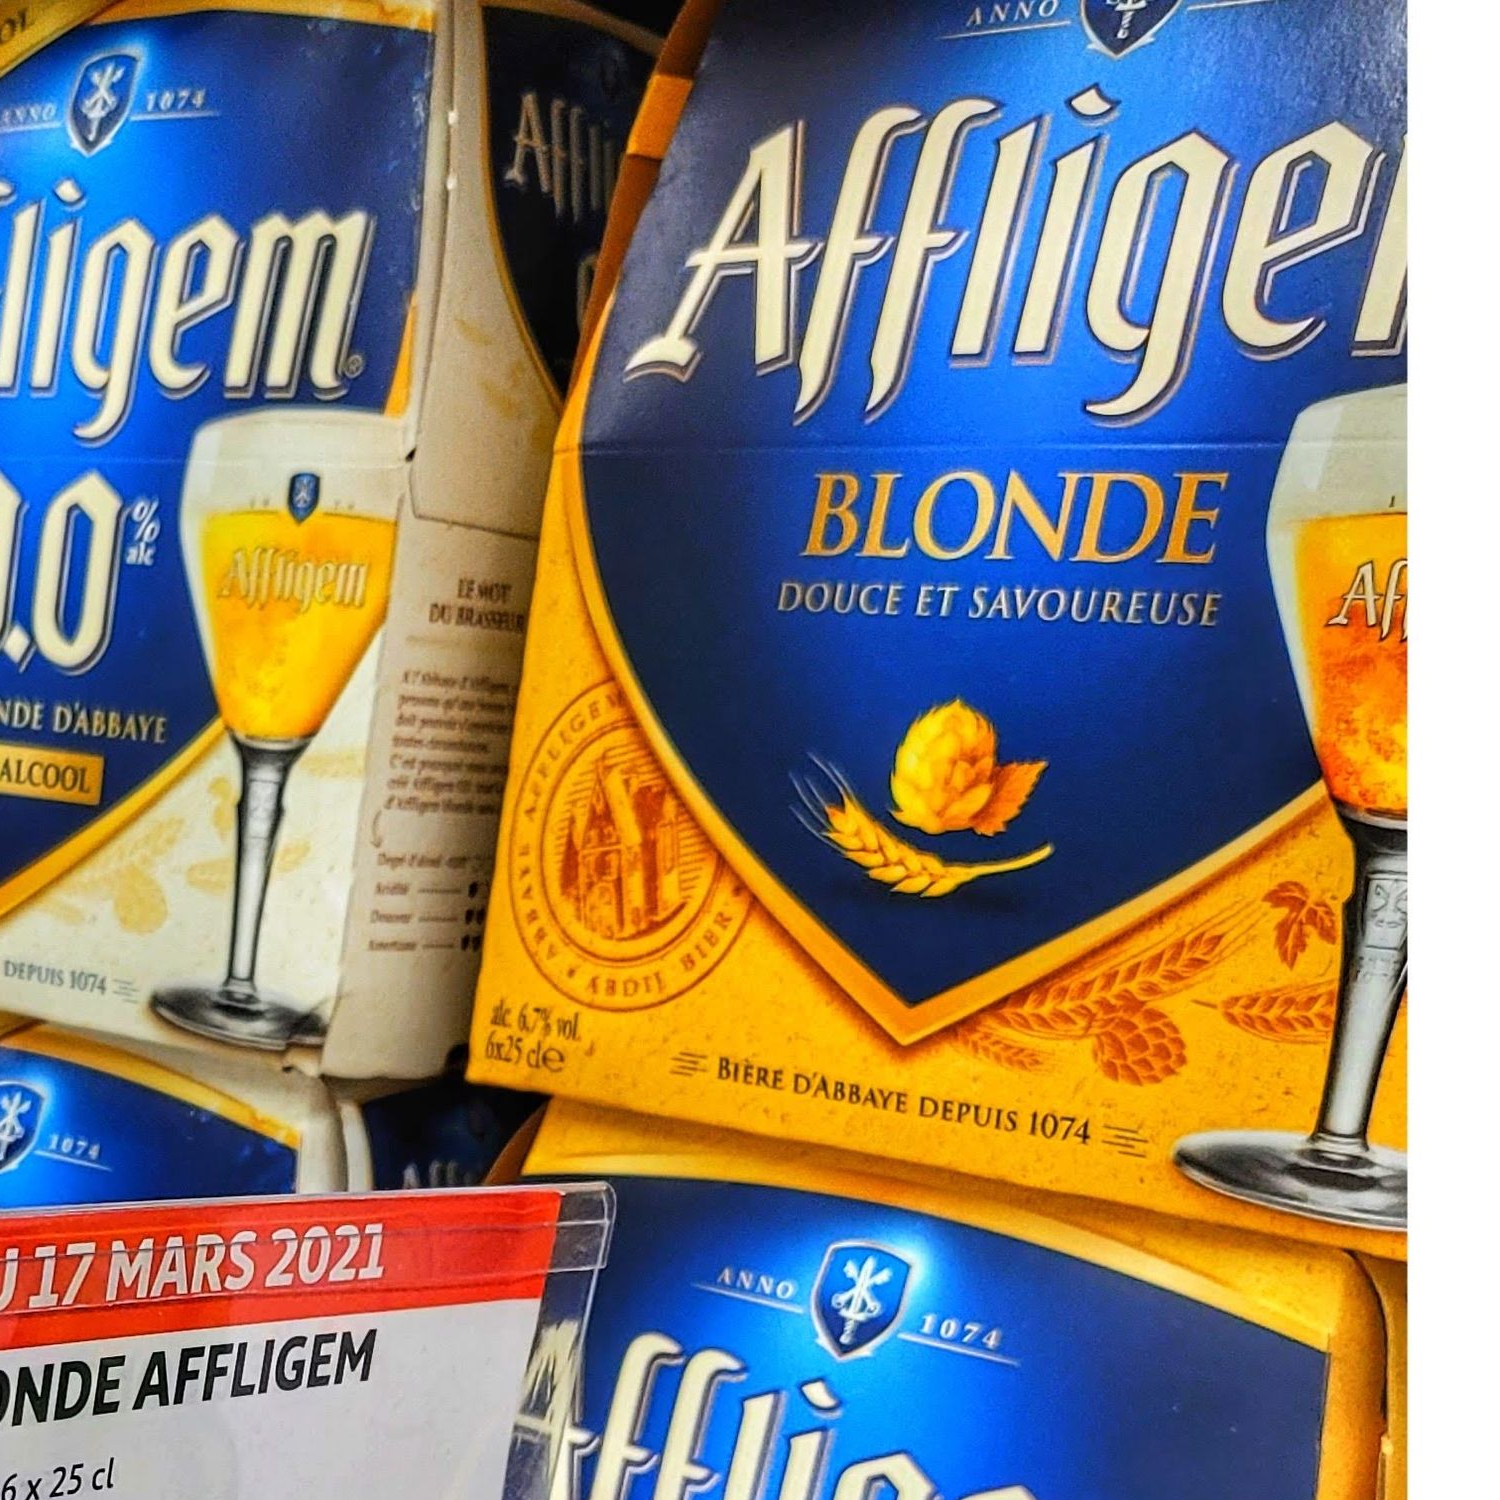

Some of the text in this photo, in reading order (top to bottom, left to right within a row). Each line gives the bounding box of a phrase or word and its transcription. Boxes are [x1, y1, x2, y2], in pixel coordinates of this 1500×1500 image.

[800, 468, 1230, 564] BLONDE
[217, 546, 370, 615] Affligem
[776, 580, 1223, 627] DOUCE ET SAVOUREUSE
[52, 702, 168, 744] D'ABBAYE
[3, 958, 65, 987] DEPUIS
[70, 969, 108, 996] 1074
[716, 1056, 1092, 1146] BIÈRE D'ABBAYE DEPUIS 1074
[26, 1240, 98, 1311] 17
[105, 1230, 258, 1303] MARS
[267, 1222, 386, 1290] 2021
[716, 1266, 1001, 1350] ANNO 1074
[132, 1327, 378, 1412] AFFLIGEM
[48, 1462, 84, 1500] 25
[92, 1457, 116, 1492] cl
